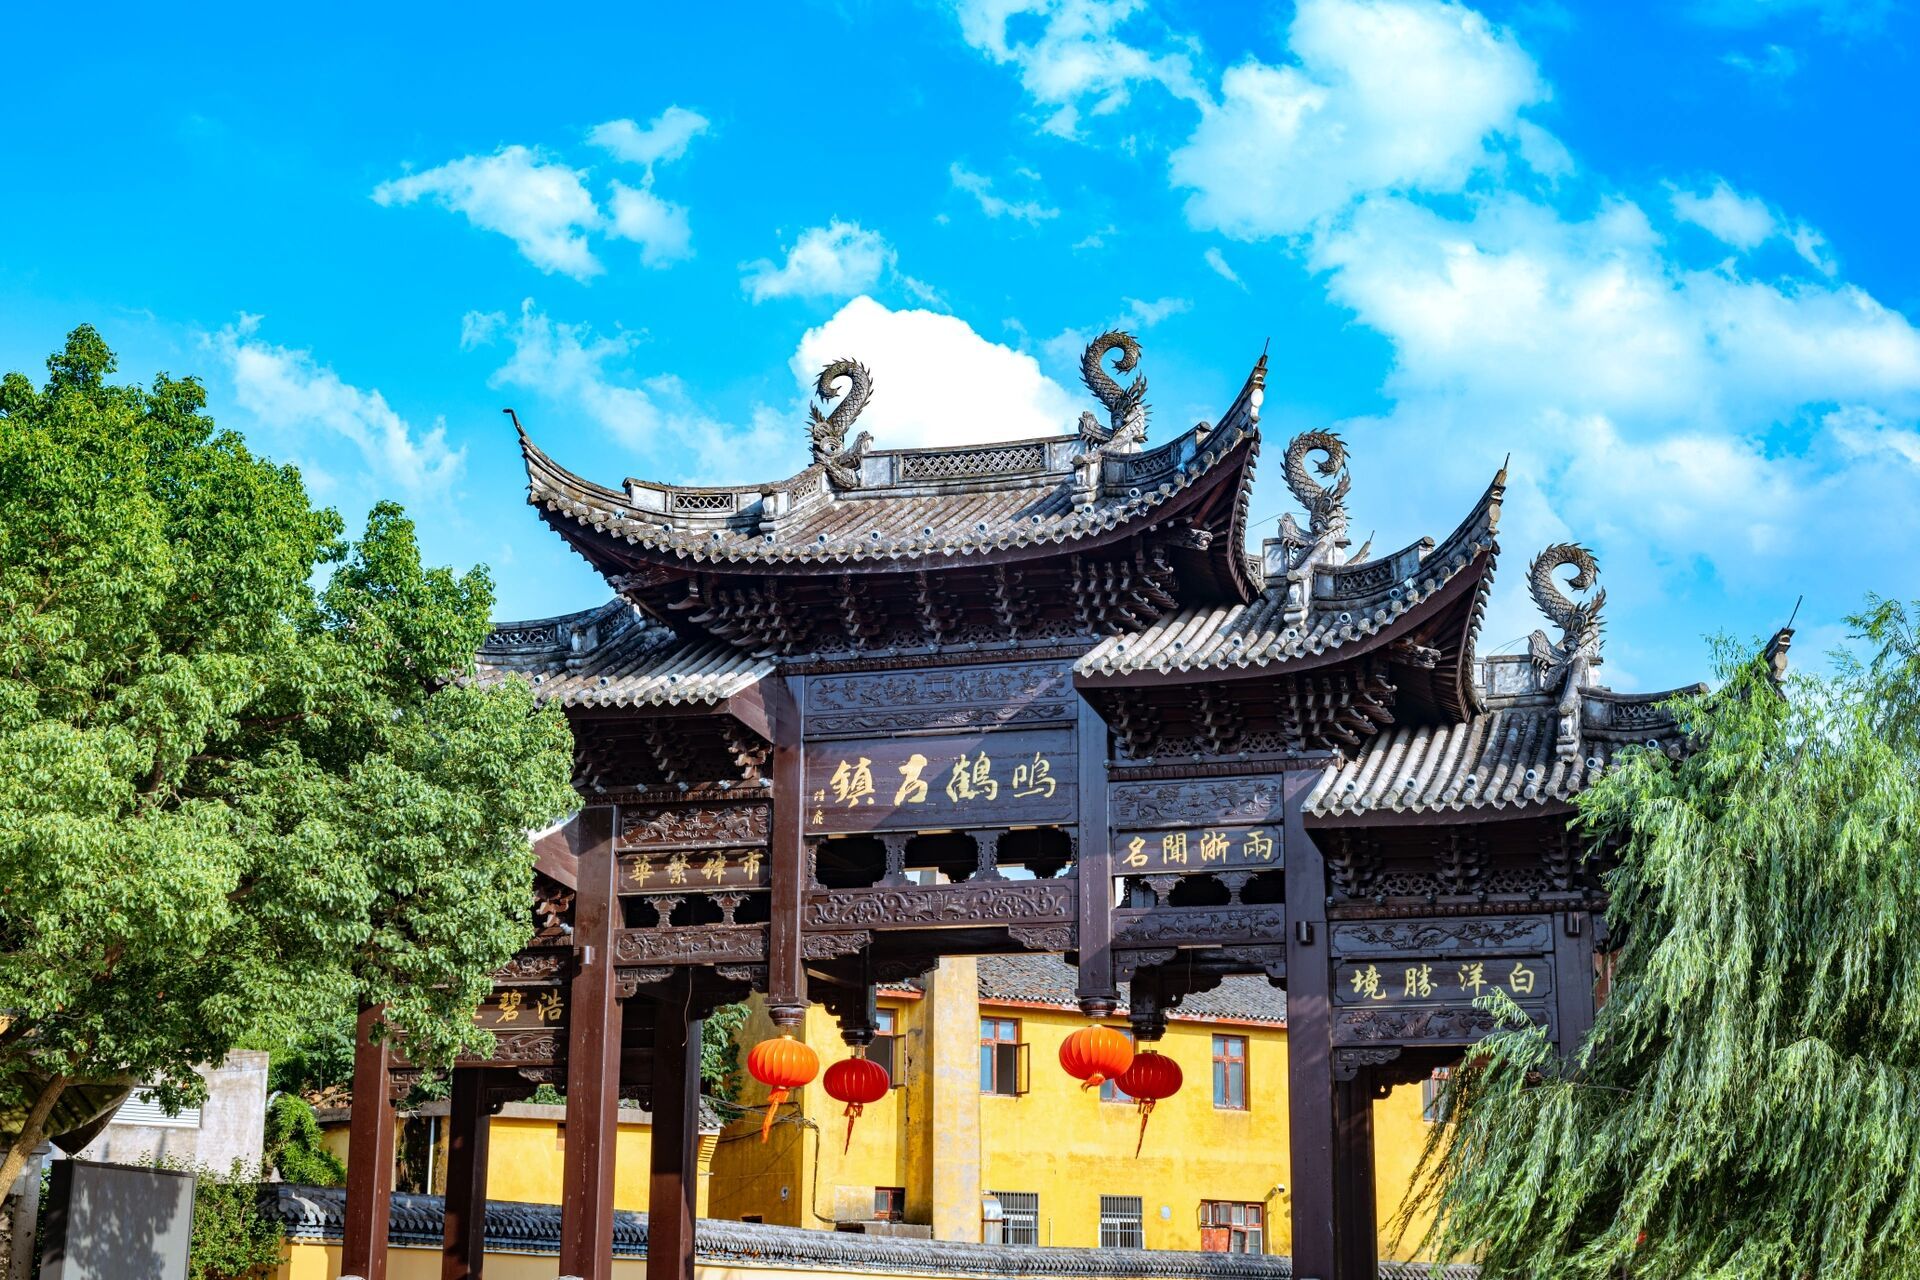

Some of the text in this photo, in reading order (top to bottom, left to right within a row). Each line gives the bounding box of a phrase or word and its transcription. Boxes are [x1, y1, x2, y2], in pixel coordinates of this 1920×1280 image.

[1350, 961, 1536, 1000] 白洋勝境
[472, 988, 565, 1024] 浩碧
